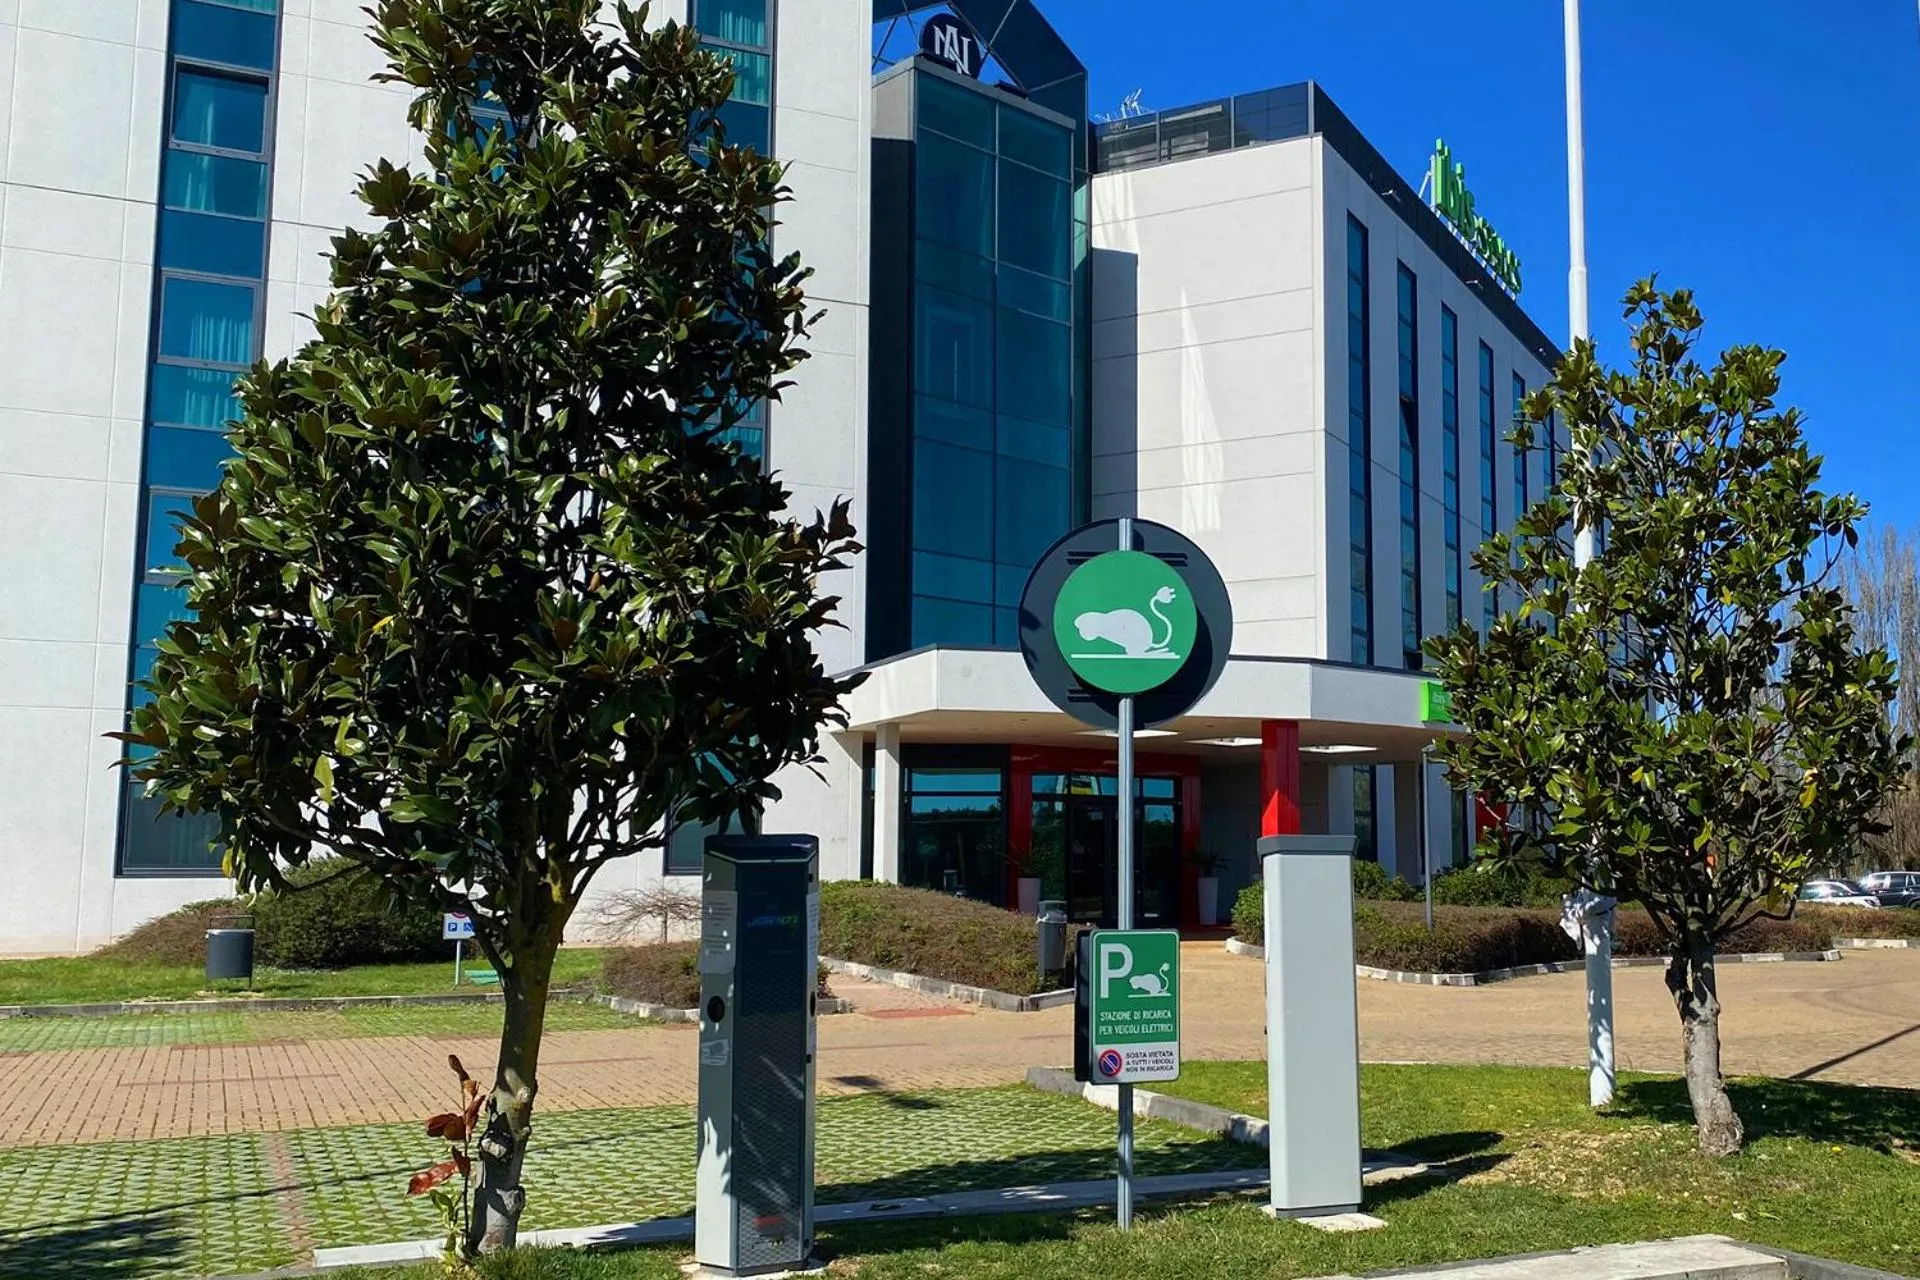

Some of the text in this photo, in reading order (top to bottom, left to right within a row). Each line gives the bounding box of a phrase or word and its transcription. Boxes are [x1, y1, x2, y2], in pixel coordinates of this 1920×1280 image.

[1101, 943, 1133, 998] P
[1100, 1010, 1172, 1021] STAZIONE DI RICARICA
[1100, 1023, 1173, 1035] PER VEICOLI ELETTRICI
